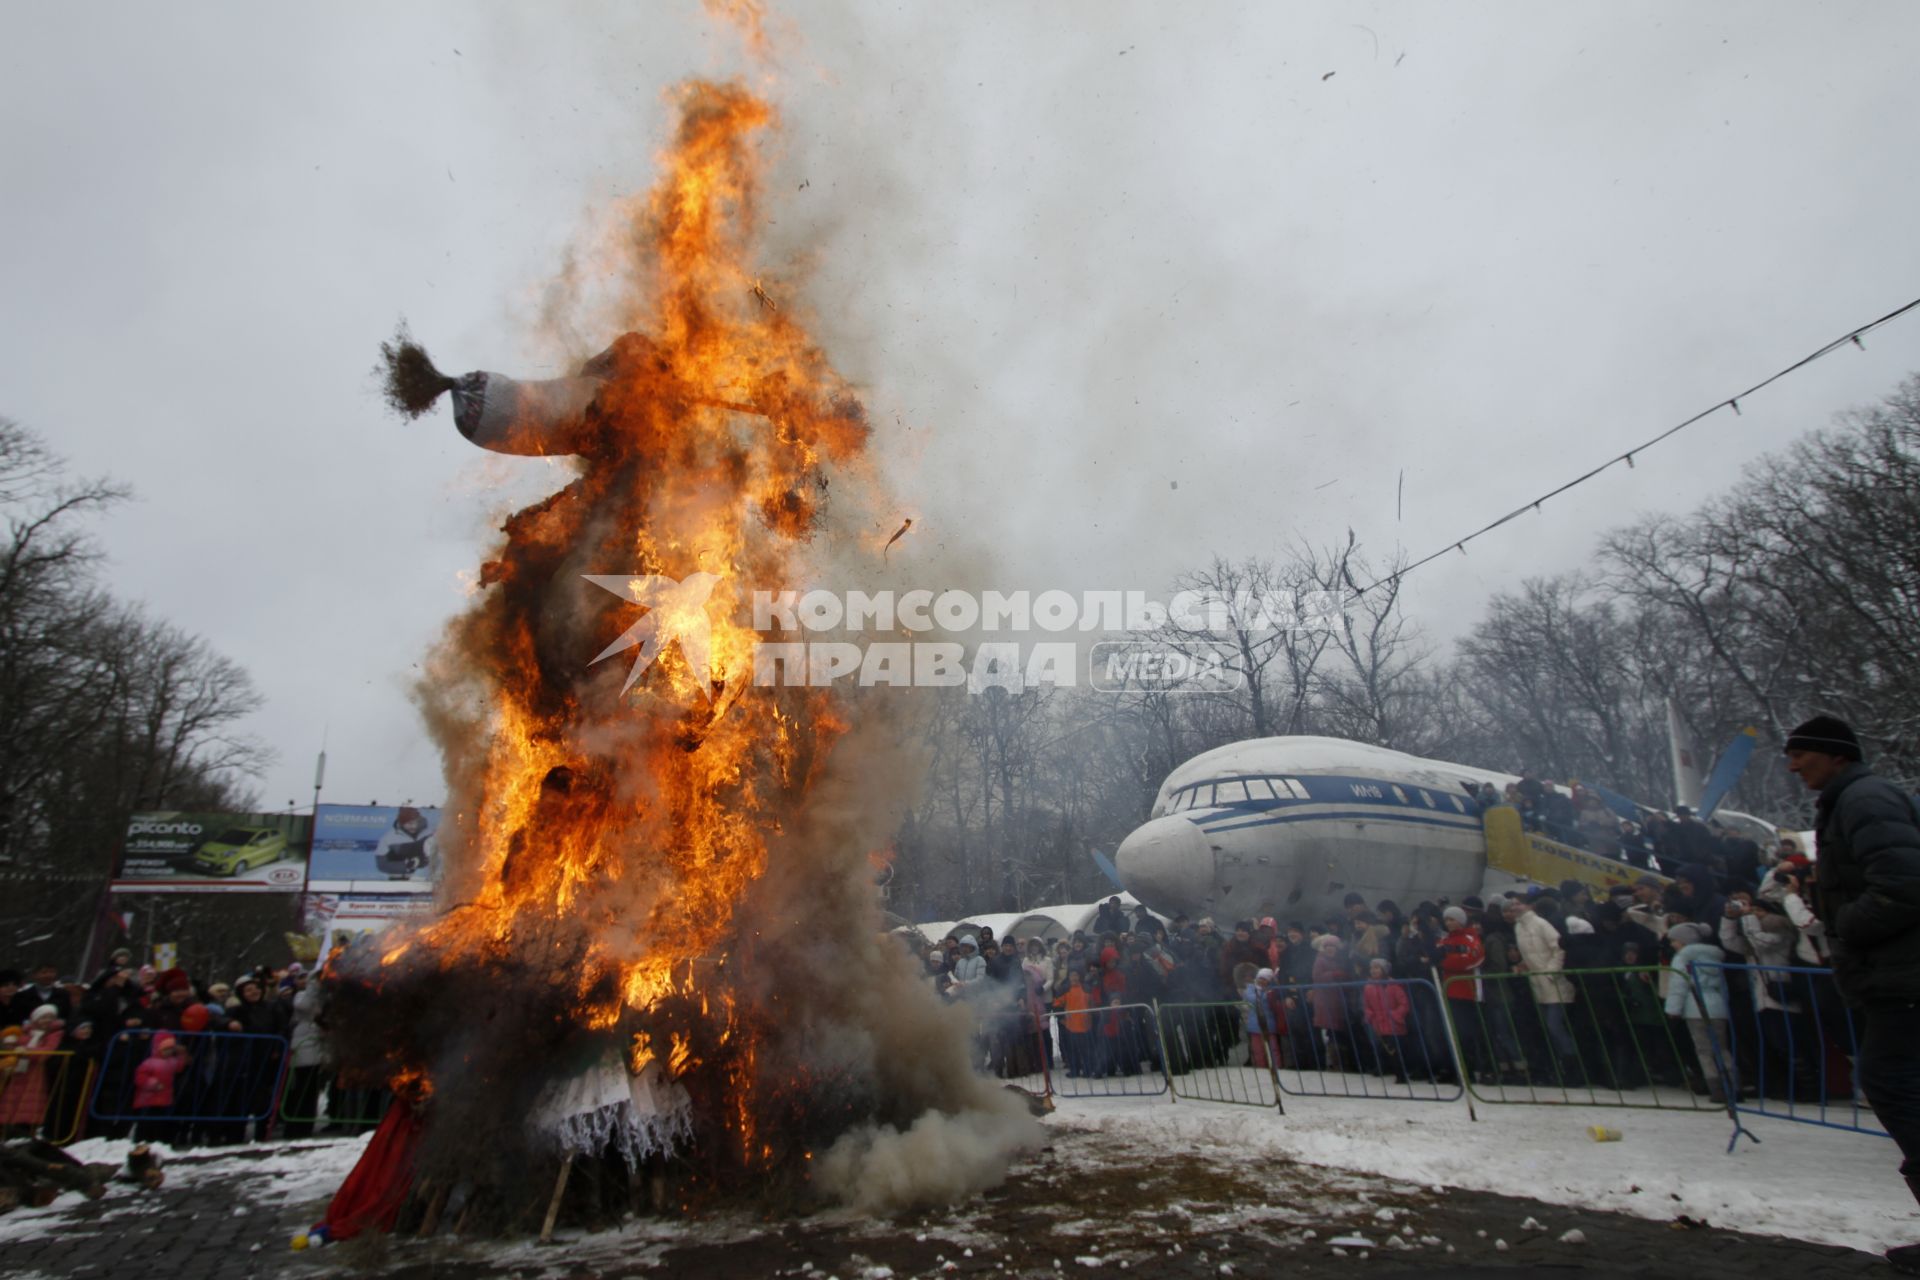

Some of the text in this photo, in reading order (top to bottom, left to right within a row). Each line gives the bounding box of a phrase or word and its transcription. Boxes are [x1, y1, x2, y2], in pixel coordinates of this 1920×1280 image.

[324, 813, 387, 824] NORMANN
[127, 820, 203, 837] picanto
[1532, 840, 1628, 878] КОМНАТА
